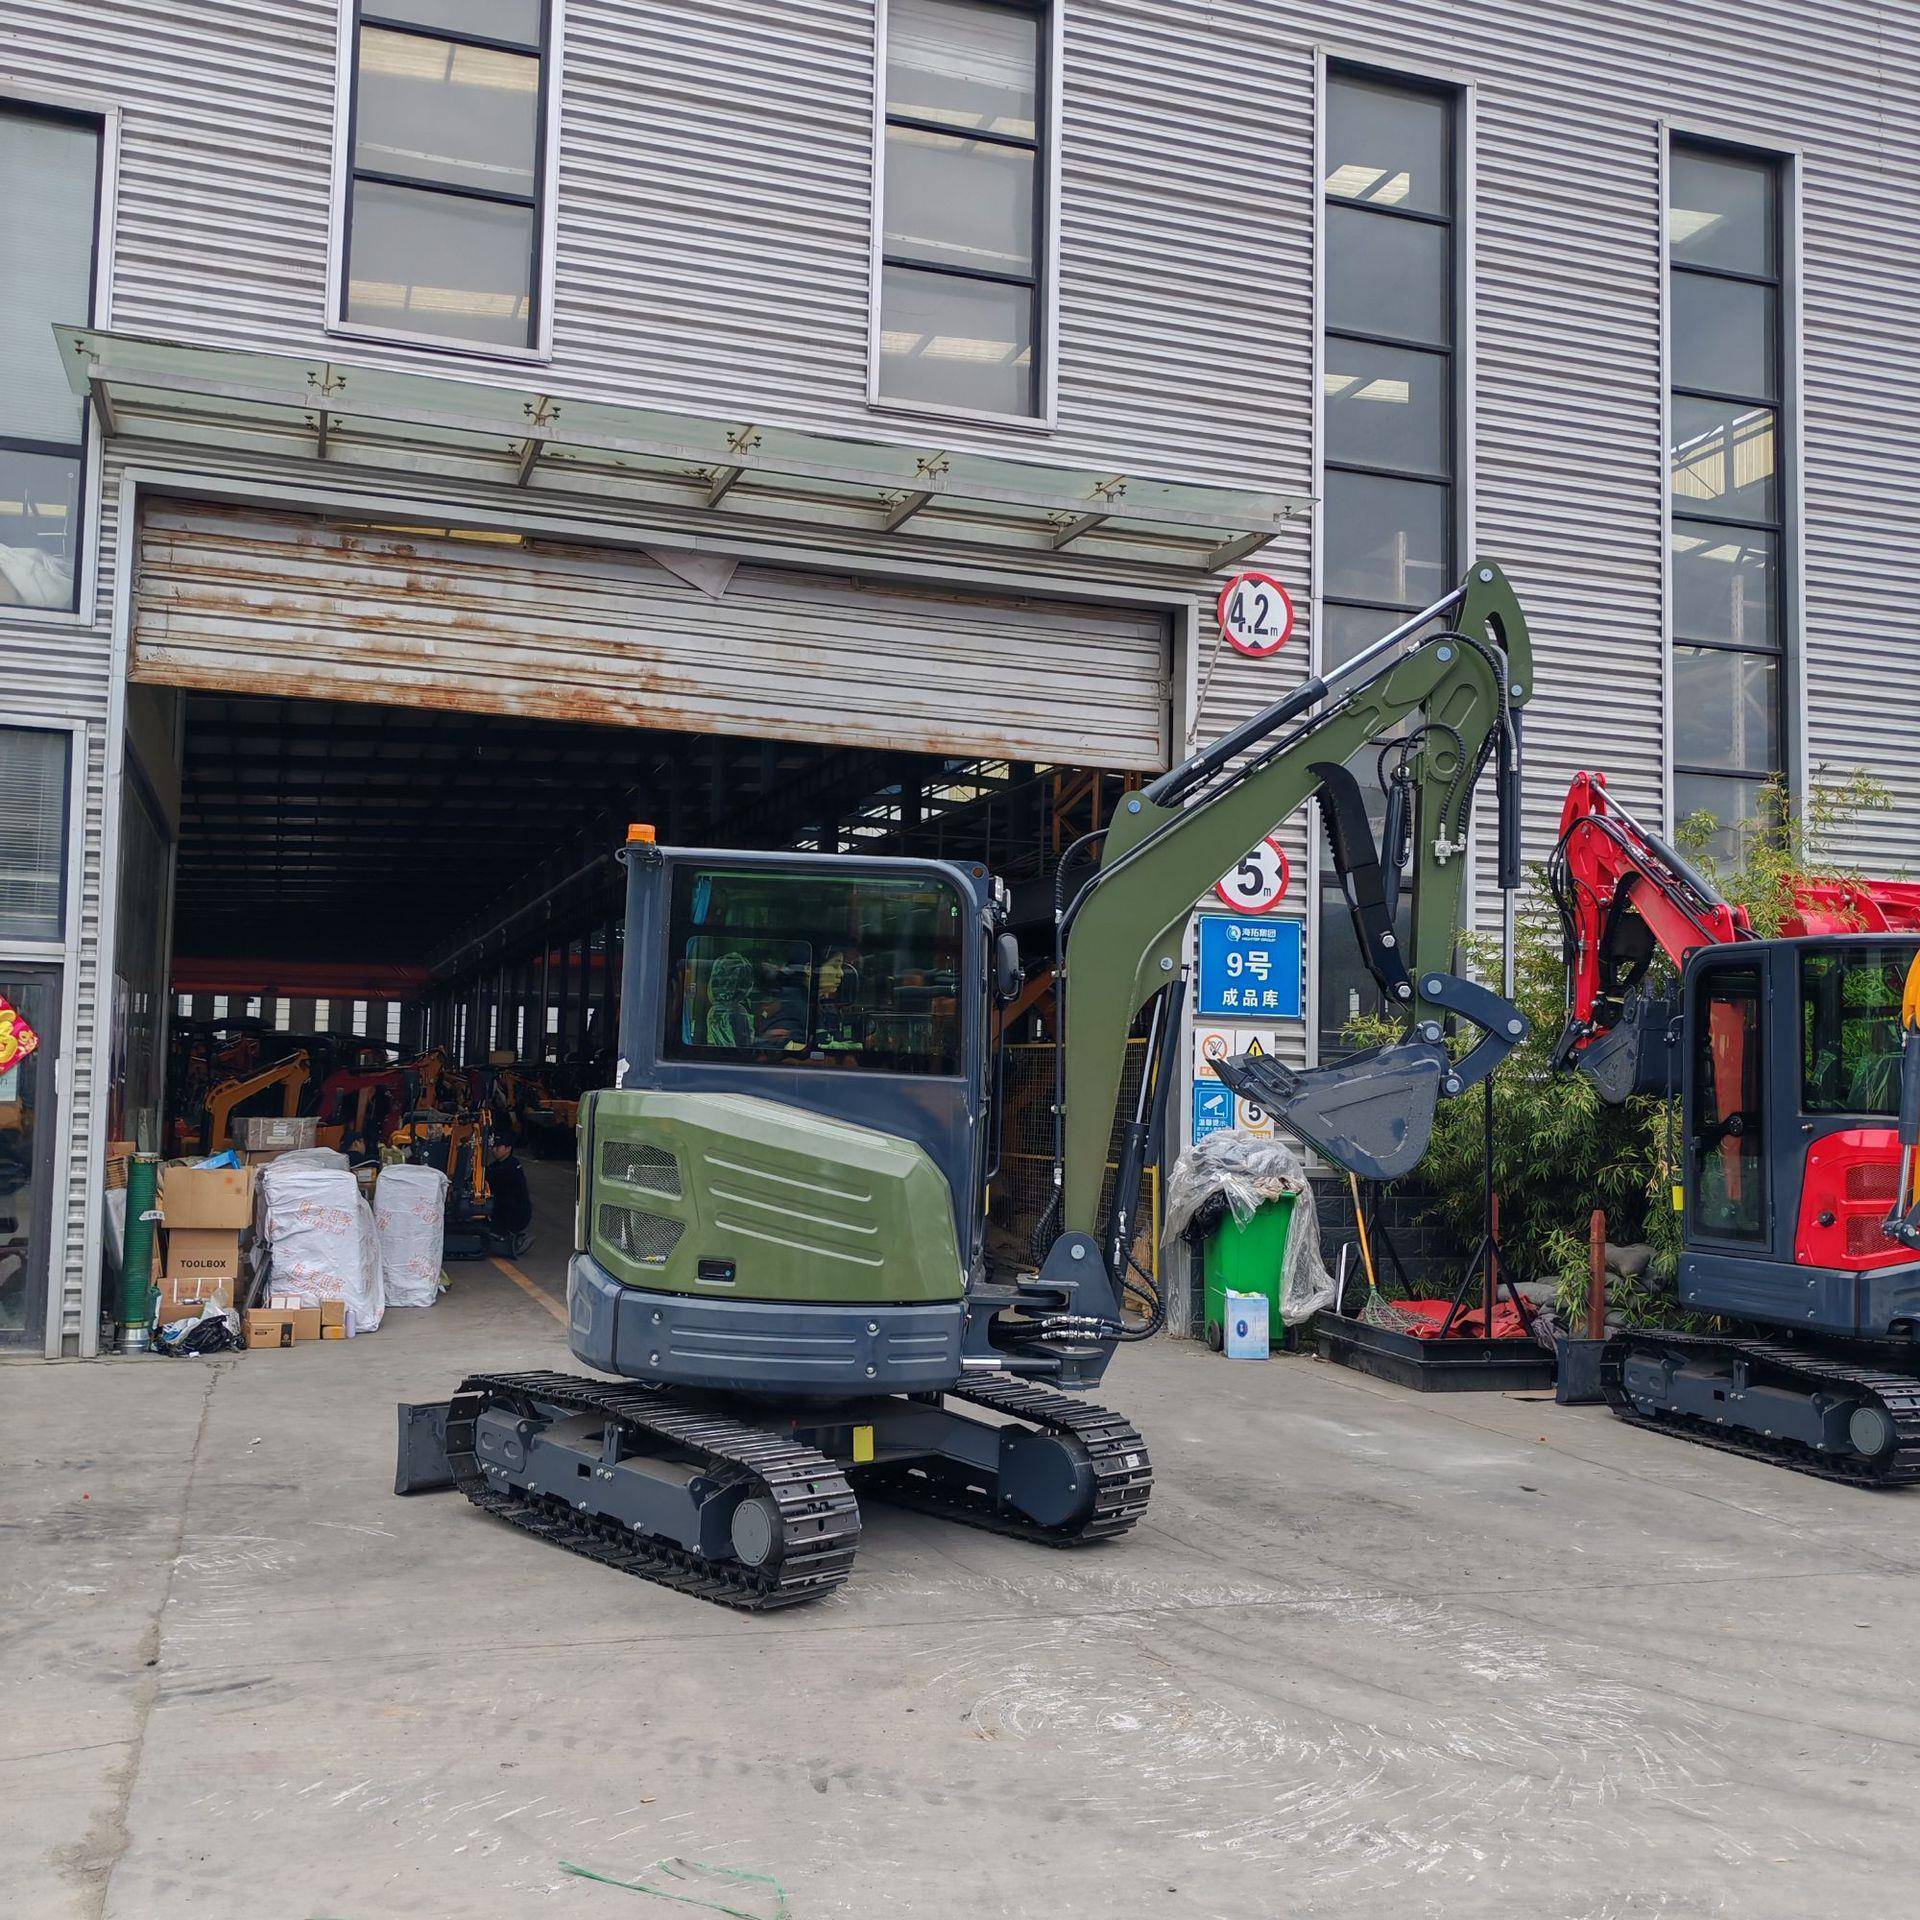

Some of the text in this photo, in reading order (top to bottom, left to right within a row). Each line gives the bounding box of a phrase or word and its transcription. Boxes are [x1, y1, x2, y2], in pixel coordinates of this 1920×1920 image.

[1226, 951, 1272, 981] 9号
[1222, 987, 1279, 1008] 成品库
[1248, 1101, 1262, 1122] 5
[180, 1260, 226, 1268] TOOLBOX
